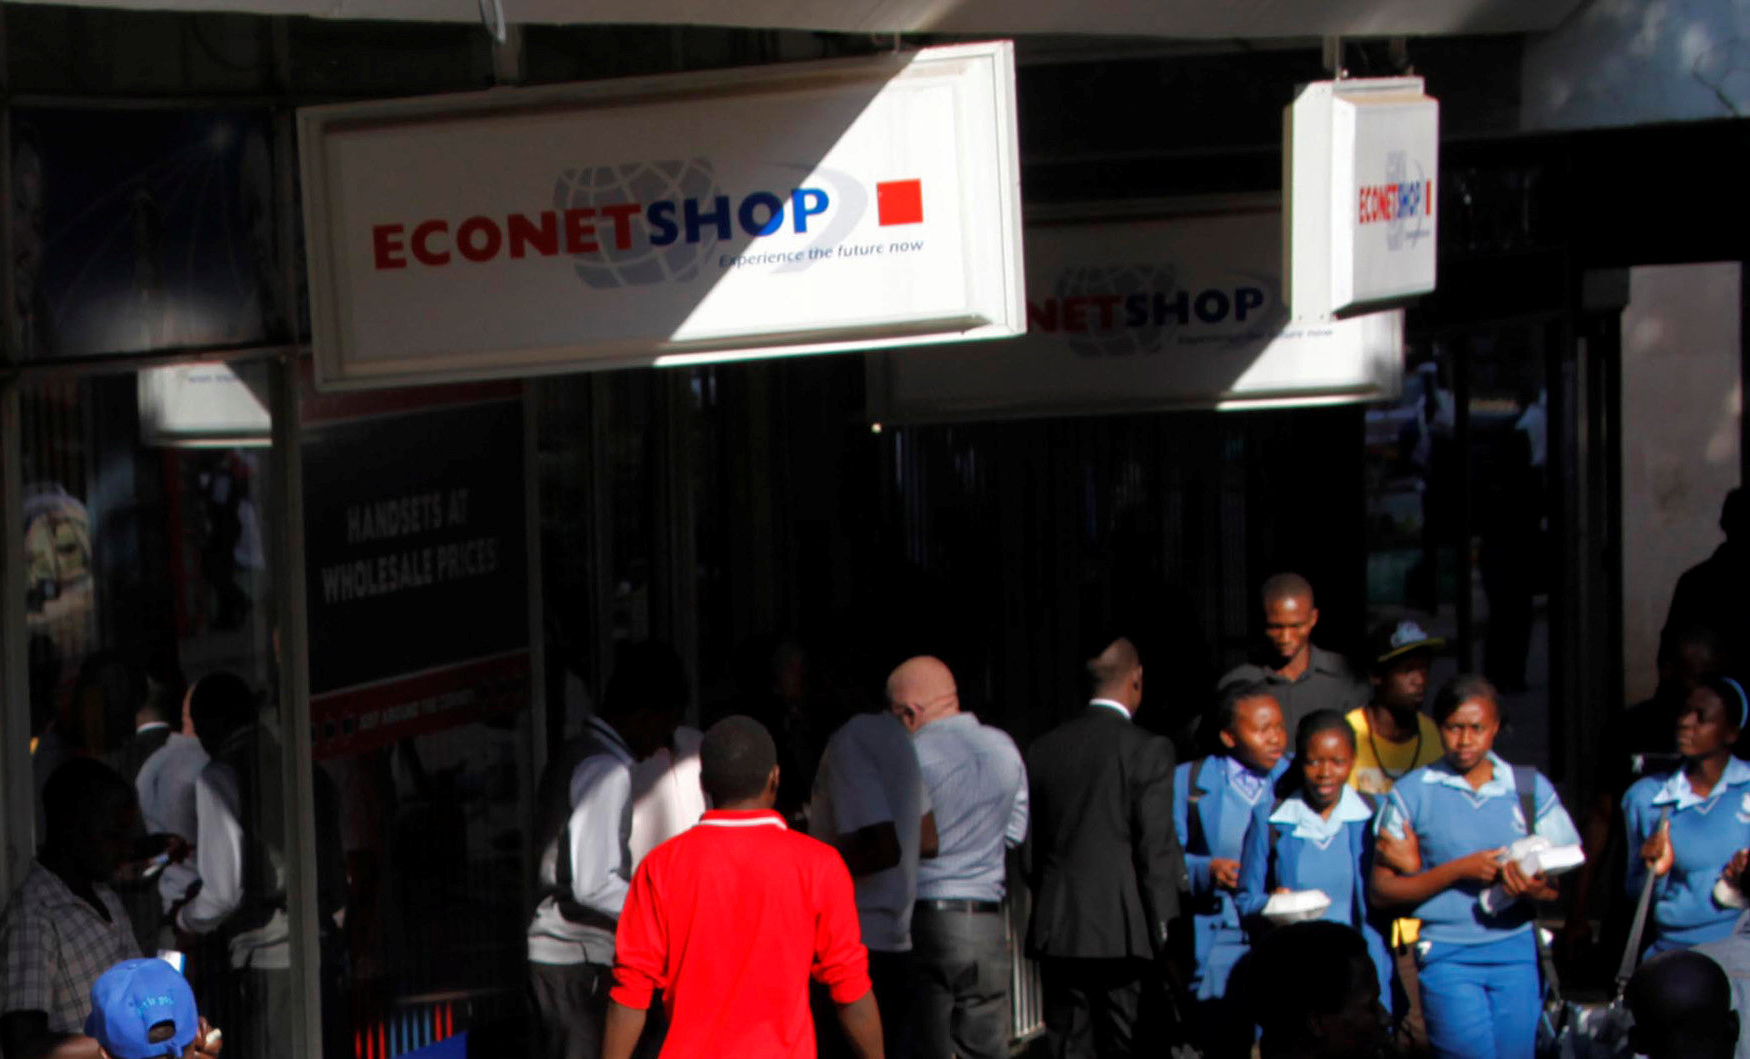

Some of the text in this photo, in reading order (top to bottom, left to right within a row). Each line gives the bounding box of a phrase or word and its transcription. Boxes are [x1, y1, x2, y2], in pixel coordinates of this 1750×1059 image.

[372, 188, 829, 270] ECONETSHOP
[719, 239, 925, 269] Experience the future now
[1028, 286, 1264, 333] NETSHOP
[346, 490, 442, 546] HANDSETS
[320, 546, 434, 605] WHOLESALE
